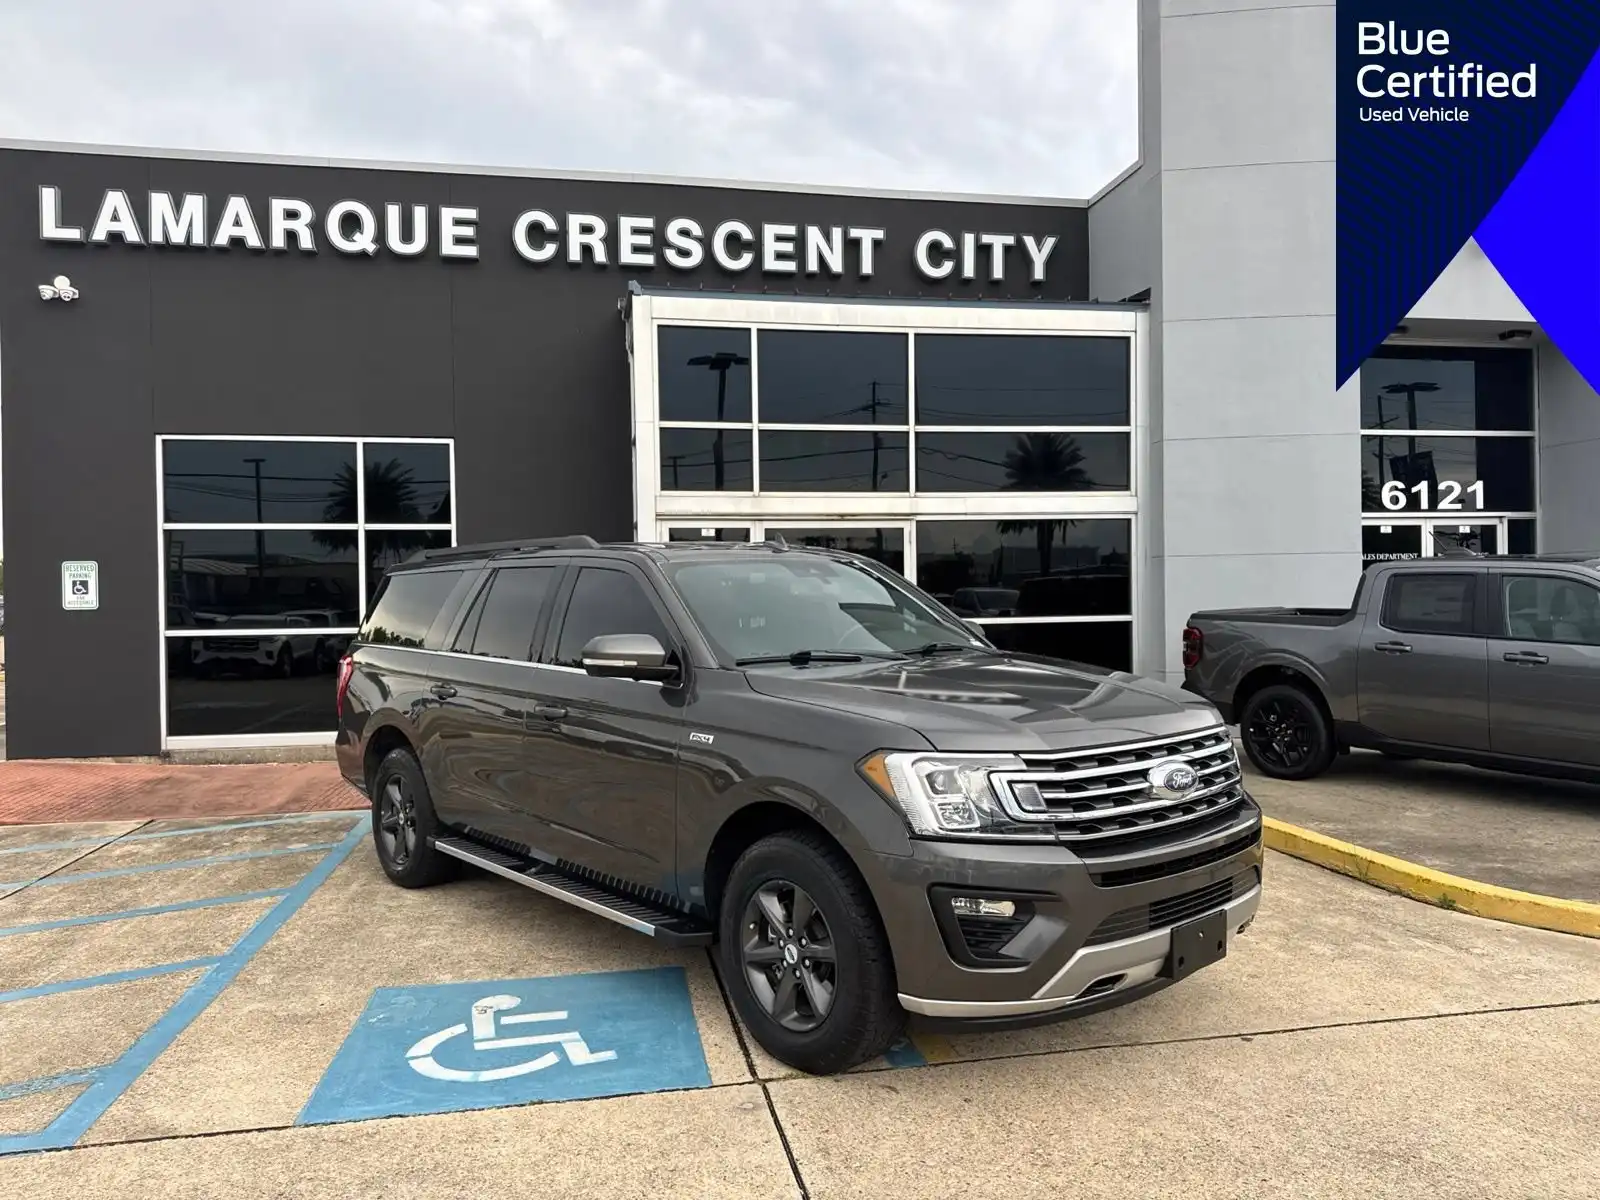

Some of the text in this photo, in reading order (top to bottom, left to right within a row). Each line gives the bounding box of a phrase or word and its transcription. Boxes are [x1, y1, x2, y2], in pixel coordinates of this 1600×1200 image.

[38, 184, 1060, 283] LAMARQUE CRESCENT CITY
[1381, 480, 1485, 510] 6121
[1361, 552, 1418, 560] ALES DEPARTMENT
[65, 564, 94, 572] RESERVED
